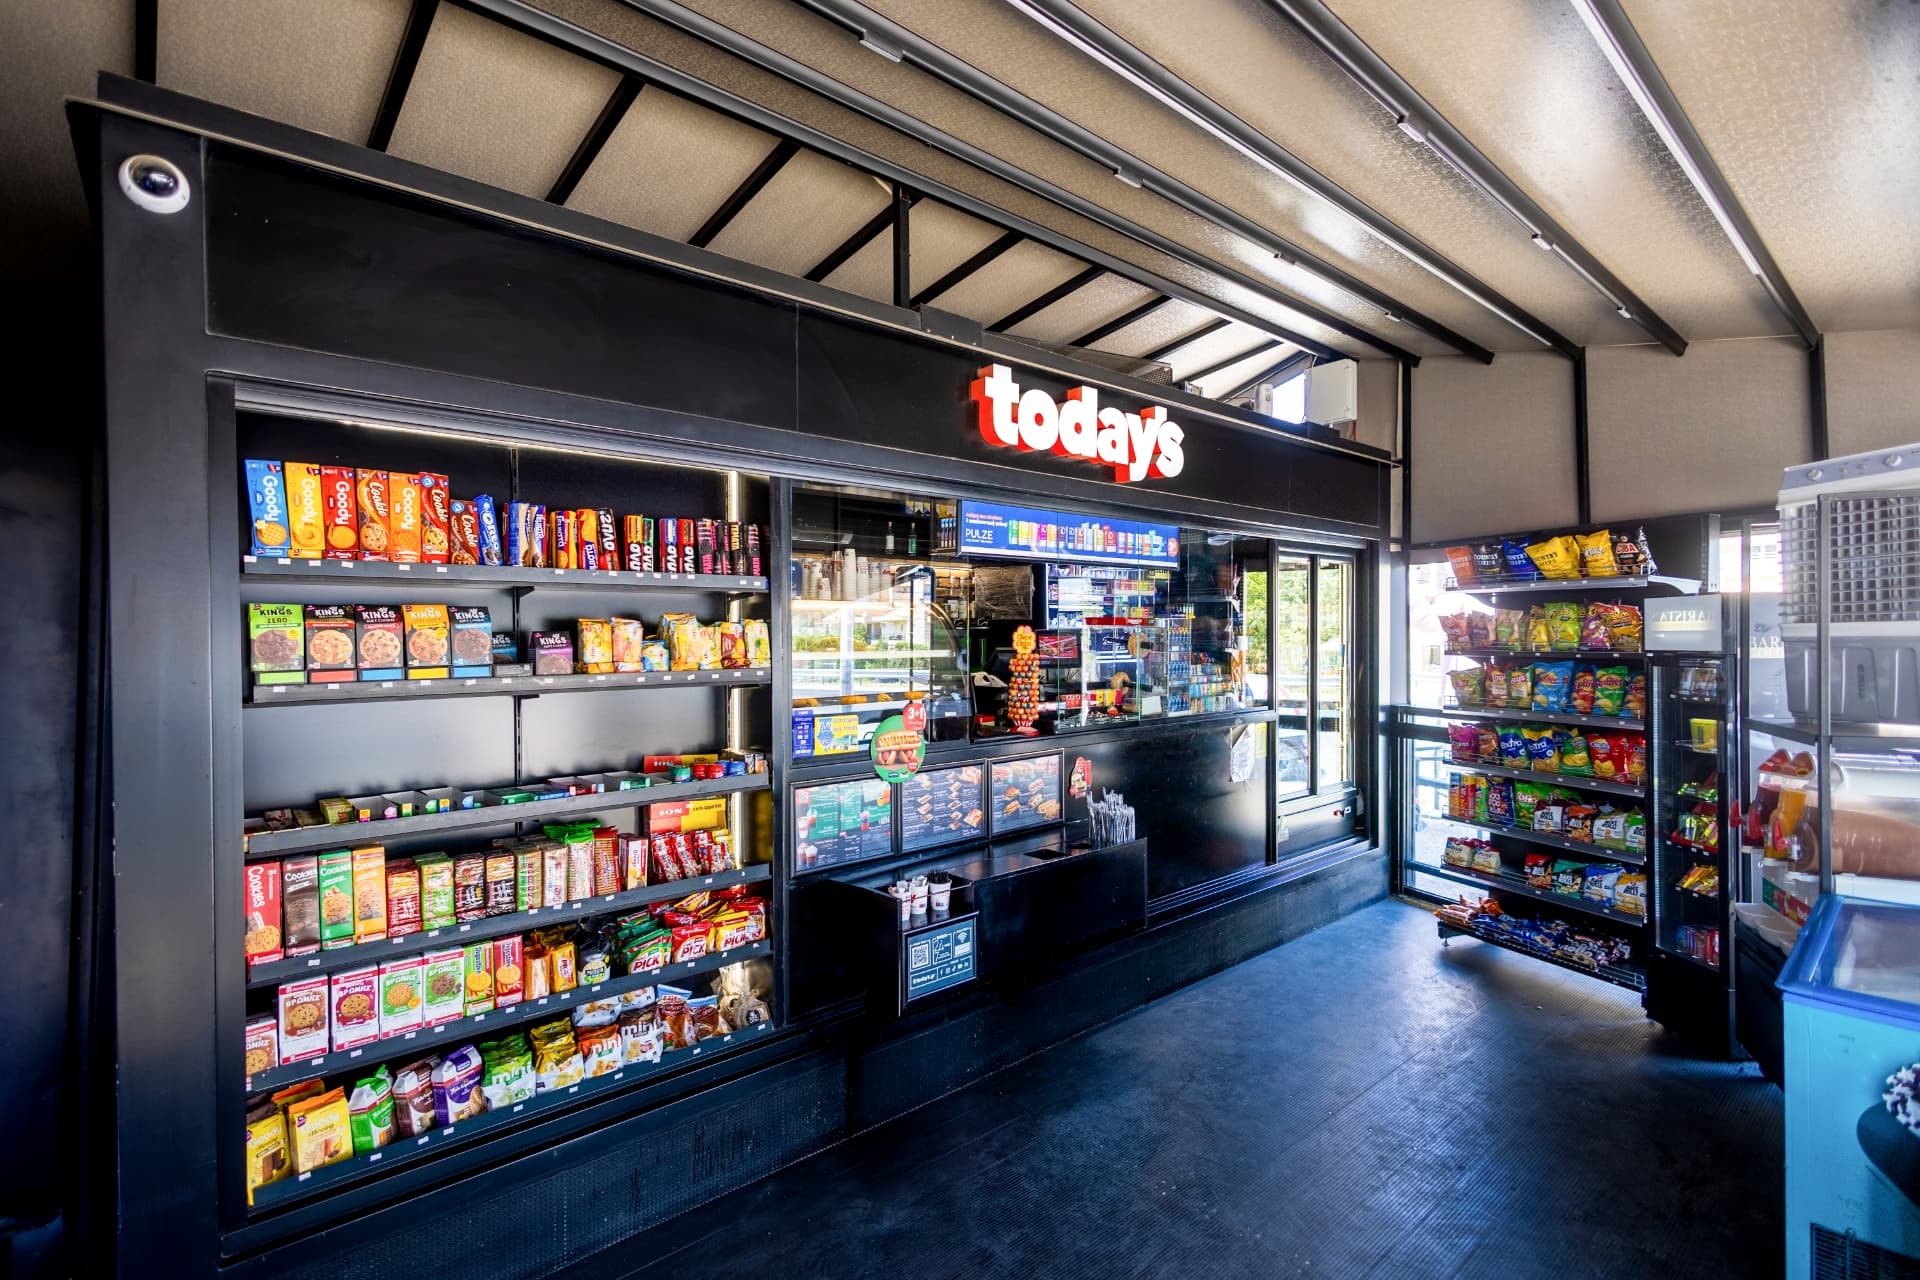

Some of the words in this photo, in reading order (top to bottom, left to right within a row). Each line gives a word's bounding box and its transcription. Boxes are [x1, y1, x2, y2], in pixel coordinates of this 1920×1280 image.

[972, 363, 1184, 482] today's
[262, 475, 282, 522] Goody
[301, 478, 316, 529] Goody
[335, 481, 350, 525] Goody
[369, 481, 388, 517] Cookie
[400, 487, 416, 530] Goody
[431, 489, 449, 523] Cookie
[461, 514, 477, 548] Cookie
[966, 528, 993, 540] PULZE
[260, 606, 293, 616] KINGS
[314, 608, 345, 617] KINGS
[362, 610, 396, 620] KINGS
[409, 610, 442, 619] KINGS
[455, 611, 485, 621] KINGS
[539, 636, 567, 645] KINGS
[724, 935, 746, 947] PICK
[681, 943, 705, 957] PICK
[633, 957, 659, 971] PICK
